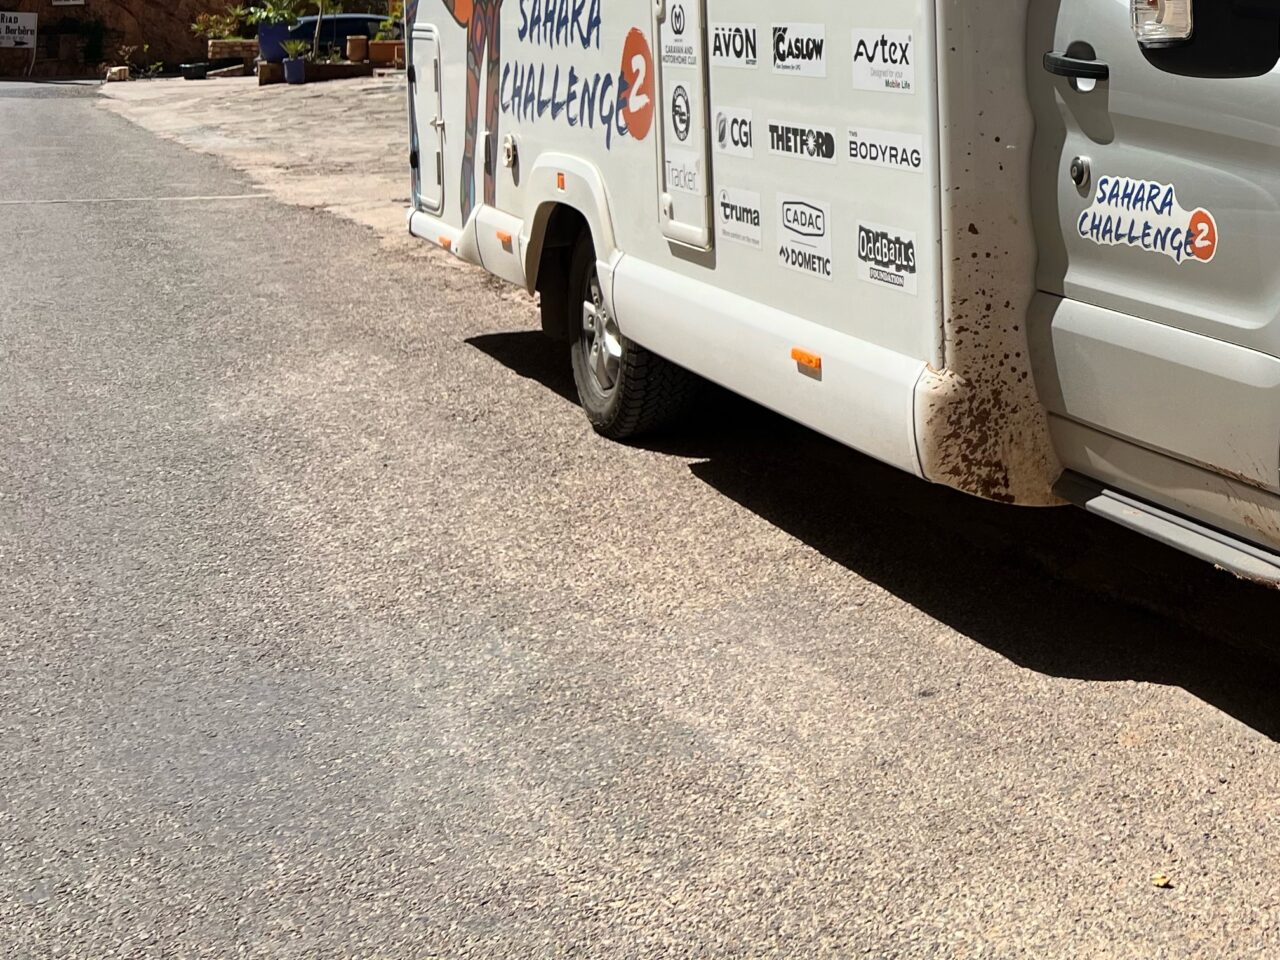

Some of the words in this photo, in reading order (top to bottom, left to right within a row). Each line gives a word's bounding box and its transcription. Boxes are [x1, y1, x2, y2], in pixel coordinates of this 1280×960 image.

[713, 26, 757, 58] AVON
[775, 32, 824, 62] GASLOW
[885, 79, 900, 88] Mobile
[901, 80, 911, 89] Life
[501, 60, 630, 151] CHALLENGE
[628, 53, 650, 113] 2
[730, 118, 752, 147] CGI
[768, 124, 835, 159] THETFORD
[849, 140, 921, 168] BODYRAG
[1097, 178, 1174, 217] SAHARA
[720, 201, 761, 227] truma
[785, 207, 822, 231] CADAC
[1079, 212, 1196, 262] CHALLENGE
[1194, 222, 1212, 248] 2
[791, 248, 831, 276] DOMETIC
